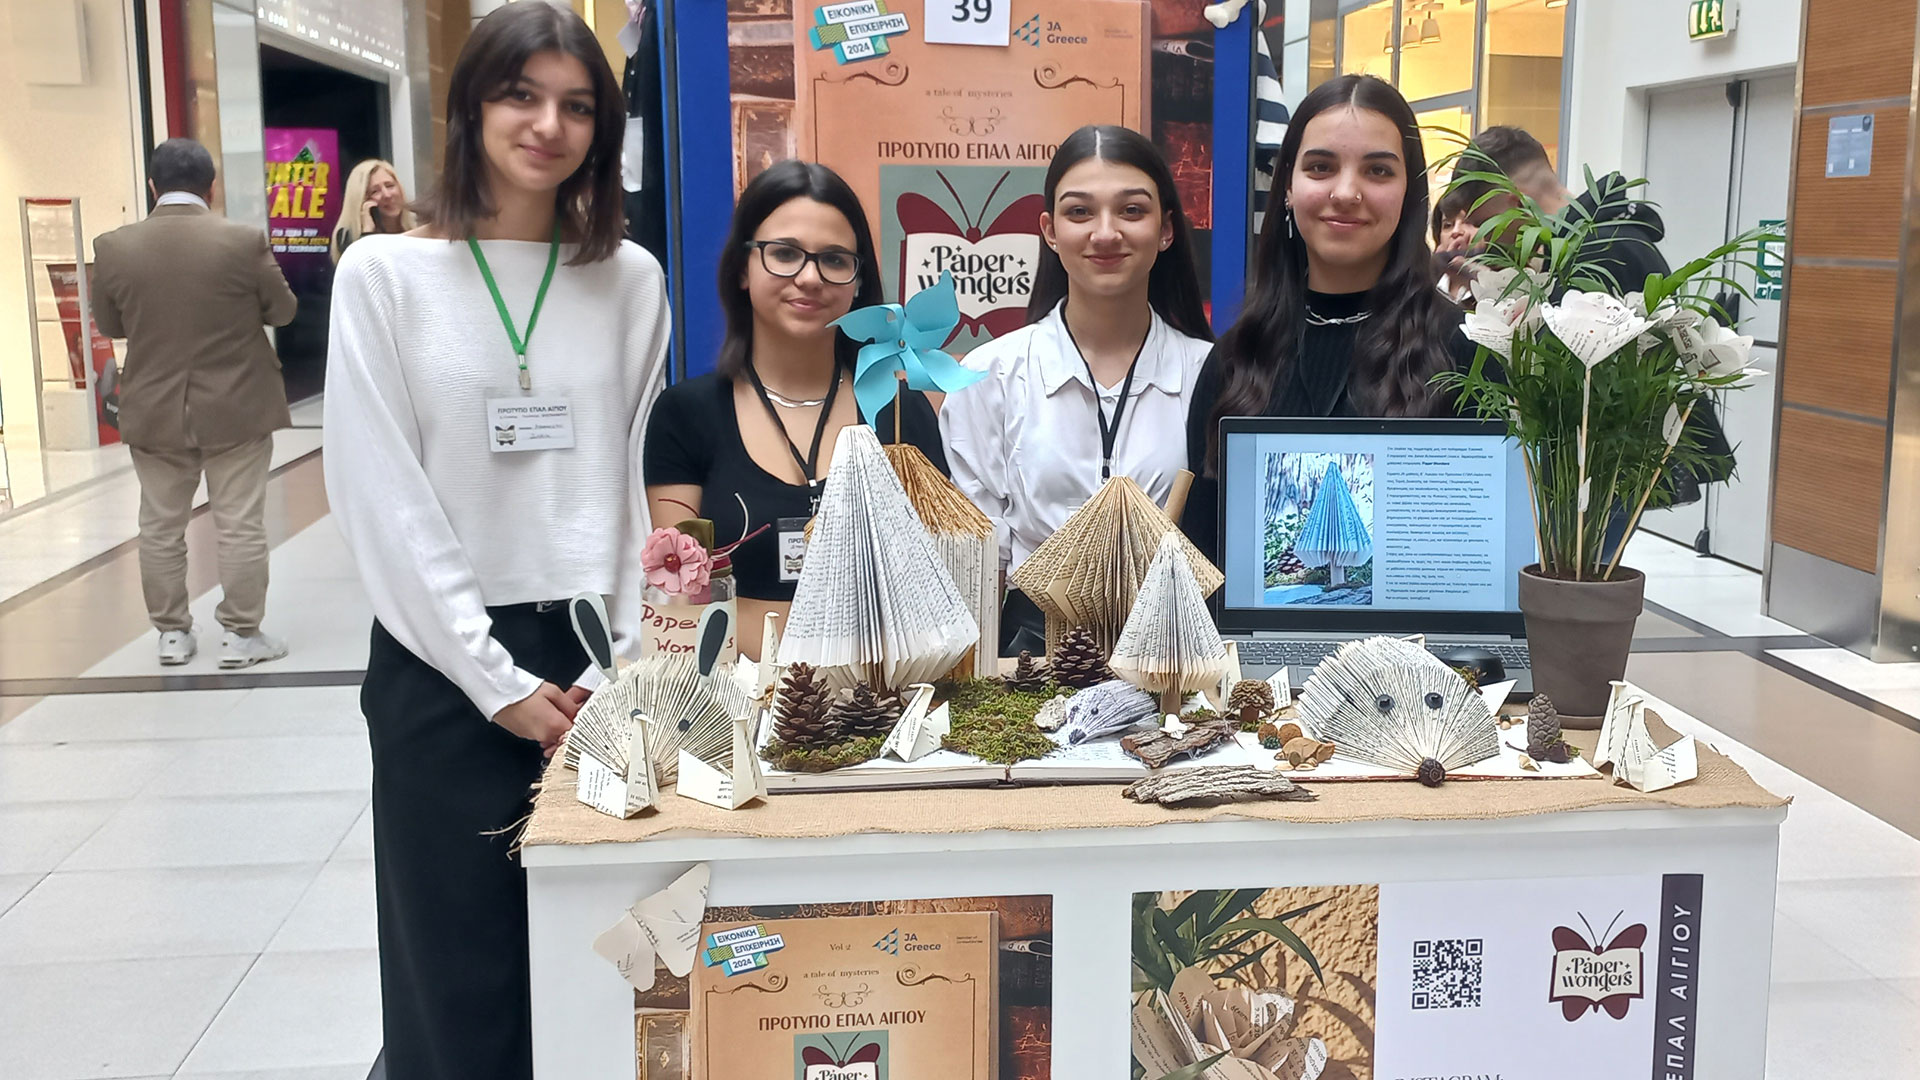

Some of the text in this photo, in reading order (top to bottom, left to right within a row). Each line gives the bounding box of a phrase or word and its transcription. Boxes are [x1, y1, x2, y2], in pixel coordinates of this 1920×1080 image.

[827, 4, 876, 20] ΕΙΚΟΝΙΚΗ
[952, 0, 992, 23] 39
[848, 18, 905, 36] ΕΠΙΧΕΙΡΗΣΗ
[1046, 21, 1062, 32] JA
[1046, 34, 1088, 44] Greece
[846, 43, 871, 55] 2024
[933, 88, 951, 97] tale
[953, 88, 963, 97] of
[967, 88, 1013, 99] mysteries
[878, 141, 1062, 160] ΠΡΟΤΥΠΟ ΕΠΑΛ ΑΙΓΙΟ
[266, 186, 328, 219] ALE
[930, 245, 1014, 275] Paper
[641, 604, 701, 633] Pape
[716, 929, 757, 944] ΕΙΚΟΝΙΚΗ
[904, 933, 918, 941] JA
[734, 937, 781, 954] ΕΠΙΧΕΙΡΗΣΗ
[904, 943, 941, 952] Greece
[732, 958, 753, 969] 2024
[1571, 957, 1623, 975] Paper
[810, 971, 826, 979] tale
[840, 970, 880, 979] mysteries
[1562, 971, 1632, 992] wonders
[1665, 904, 1691, 1080] ΕΠΑΛ ΑΙΓΙΟΥ
[759, 1010, 927, 1031] ΠΡΟΤΥΠΟ ΕΠΑΛ ΑΙΓΙΟΥ
